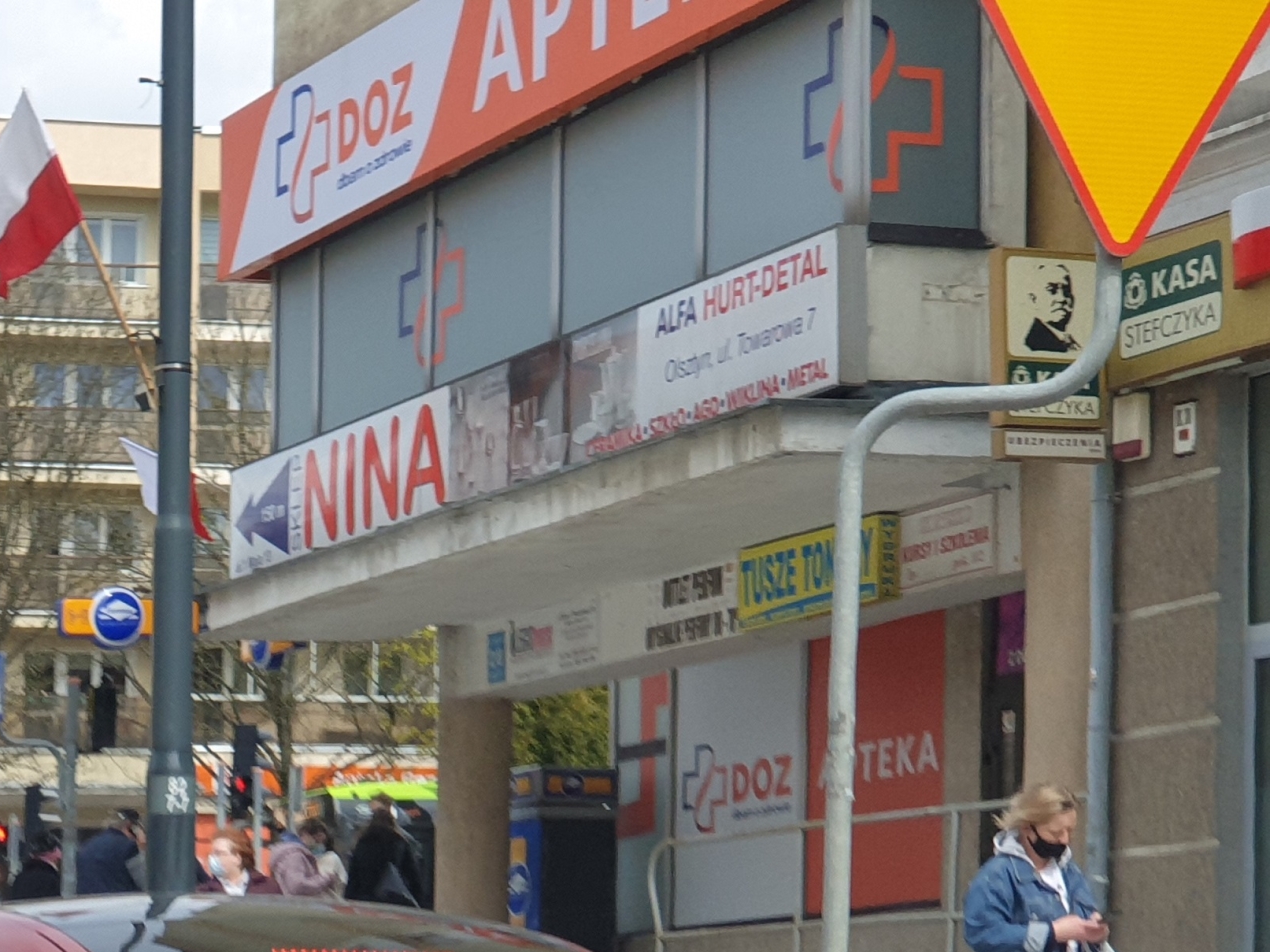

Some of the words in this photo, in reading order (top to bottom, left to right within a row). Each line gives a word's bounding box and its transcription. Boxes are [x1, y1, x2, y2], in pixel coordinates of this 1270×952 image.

[338, 61, 414, 164] DOZ
[654, 296, 698, 339] ALFA
[703, 244, 828, 321] HURT-DETAL
[1151, 254, 1218, 299] KASA
[737, 316, 804, 354] Towarowa
[807, 306, 818, 331] 7
[1125, 302, 1216, 349] STEFCZYKA
[786, 358, 829, 391] METAL
[1007, 436, 1102, 448] UBEZPIECZENIA
[304, 403, 446, 550] NINA
[741, 548, 797, 608] TUSZE
[732, 754, 793, 803] DOZ
